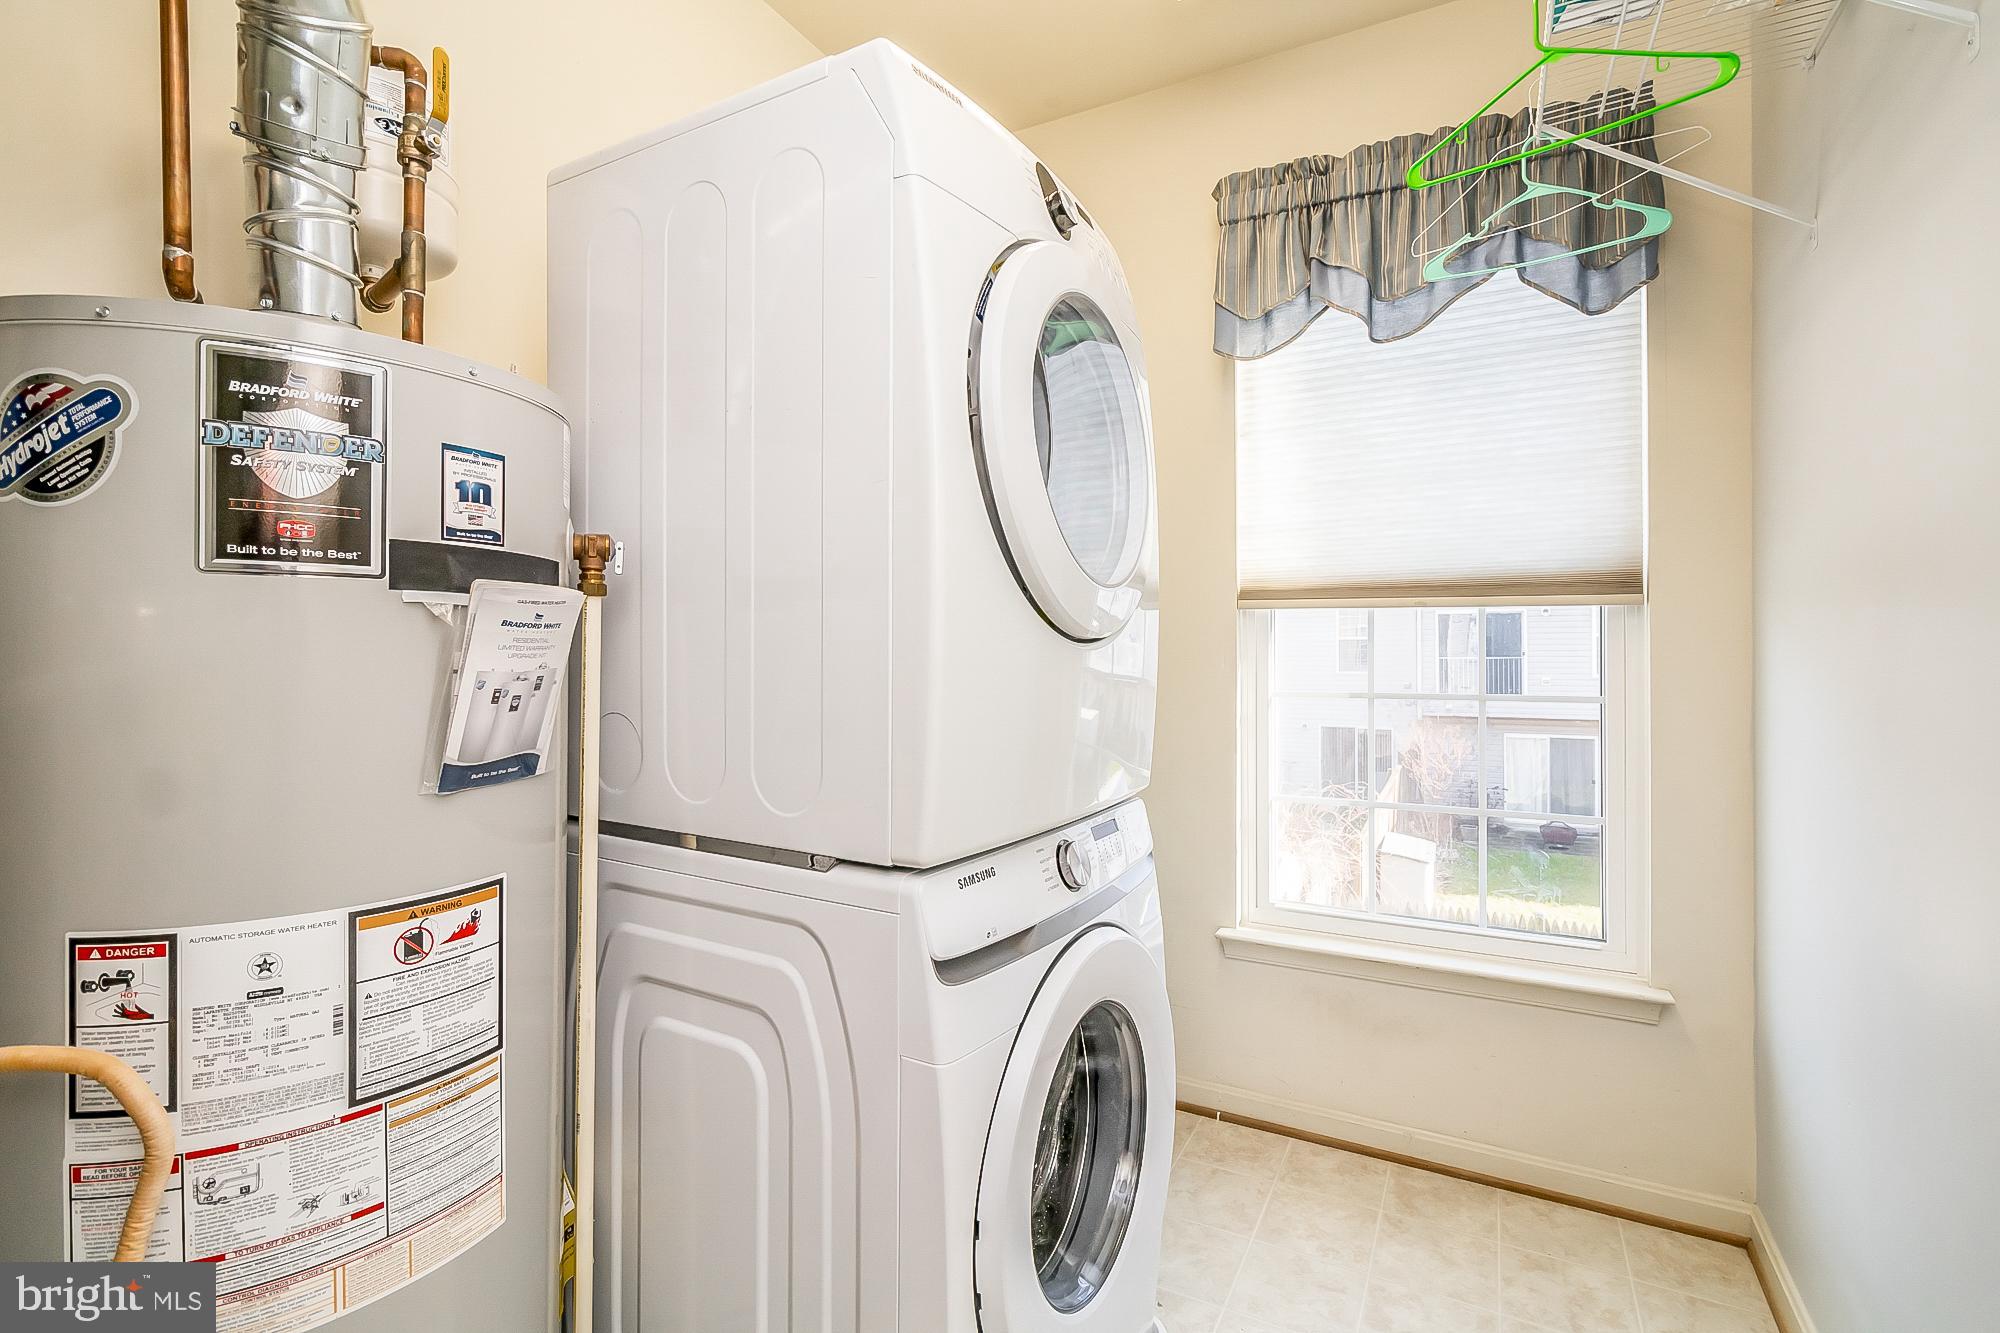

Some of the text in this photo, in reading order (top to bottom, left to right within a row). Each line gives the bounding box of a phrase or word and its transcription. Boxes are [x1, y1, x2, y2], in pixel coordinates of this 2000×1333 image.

[229, 380, 363, 408] BRADFORD WHITE
[68, 403, 86, 416] TOTAL
[71, 396, 113, 423] PERFORMANCE
[74, 413, 98, 430] SYSTEM
[0, 413, 71, 480] Hydrojet
[202, 419, 385, 463] DEFENDER
[231, 455, 359, 477] SAFETY SYSTEM
[451, 456, 498, 470] BRADFORD WHITE
[455, 480, 492, 507] 10
[280, 523, 315, 532] PHCC
[227, 544, 362, 560] Built to be the Best
[501, 620, 543, 630] BRADFORD
[958, 867, 997, 890] SAMSUNG
[421, 900, 463, 916] WARNING
[189, 920, 338, 944] AUTOMATIC STORAGE WATER HEATER
[106, 947, 155, 958] DANGER
[421, 962, 450, 975] EXPLOSION
[451, 956, 471, 967] HAZARD
[440, 1084, 453, 1094] YOUR
[454, 1077, 470, 1088] SAFETY
[443, 1074, 466, 1087] WARNING
[443, 1093, 466, 1106] WARNING
[244, 1121, 335, 1149] OPERATING INSTRUCTIONS
[247, 1244, 264, 1254] TURN
[266, 1240, 279, 1249] OFF
[281, 1235, 296, 1245] GAS
[298, 1231, 307, 1240] TO
[308, 1220, 344, 1237] APPLIANCE
[222, 1269, 325, 1304] CONTROL DIAGNOSTIC CODES
